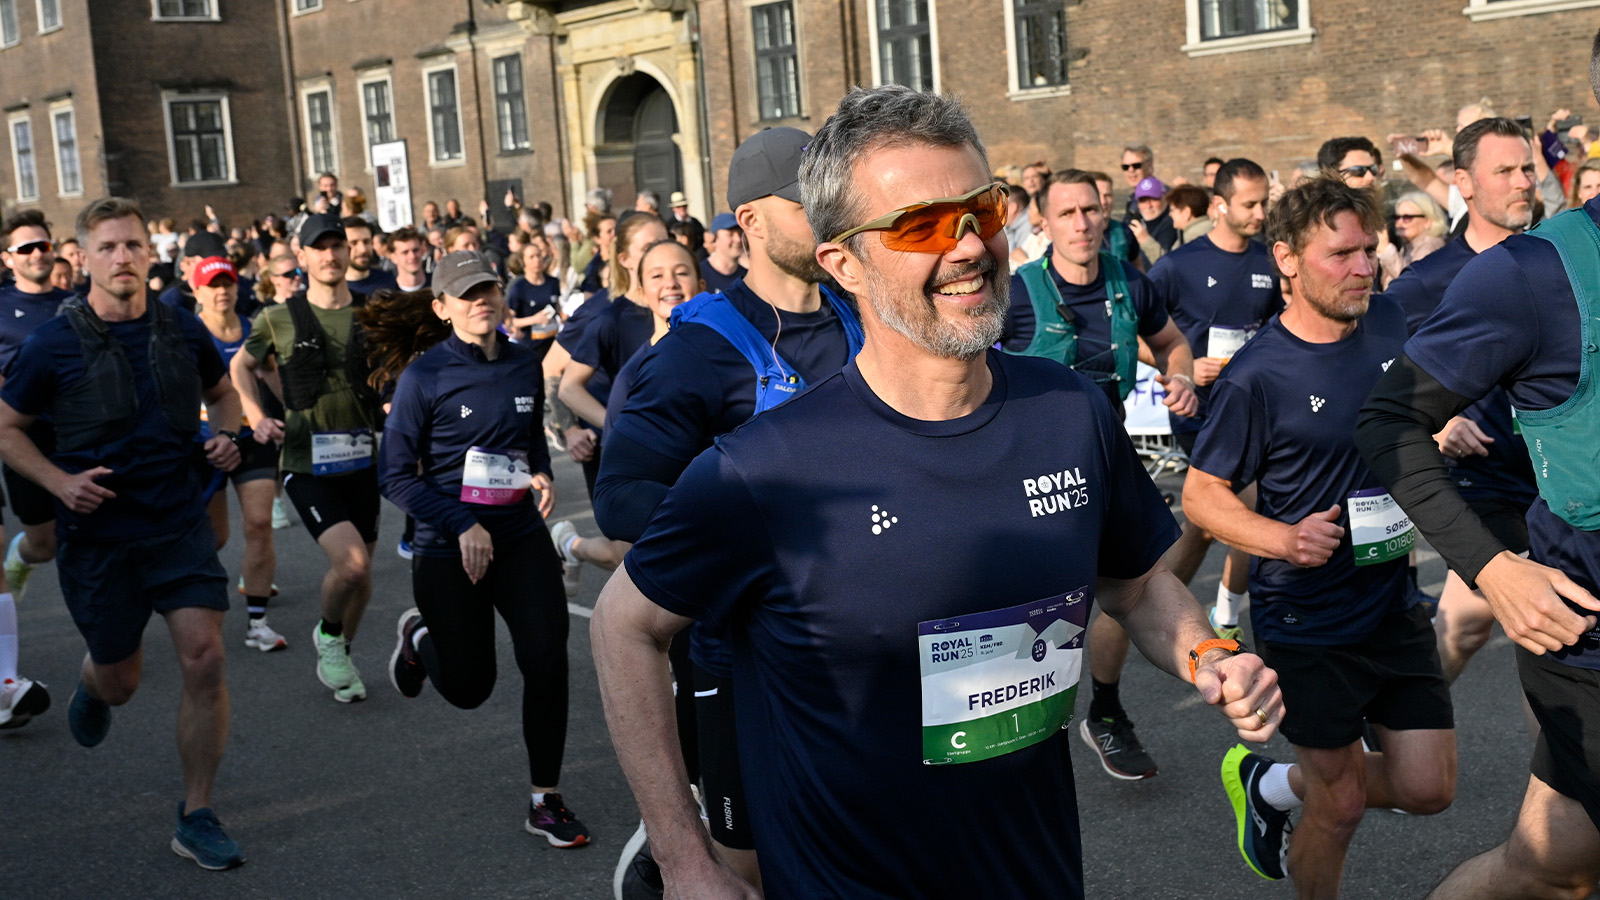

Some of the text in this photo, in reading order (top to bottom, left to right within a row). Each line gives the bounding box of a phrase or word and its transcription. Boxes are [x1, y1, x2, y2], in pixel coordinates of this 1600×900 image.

[514, 396, 535, 405] ROYA
[489, 477, 513, 486] EMILIE
[1023, 467, 1087, 497] ROYAL
[471, 489, 480, 498] D
[1368, 546, 1378, 557] C
[931, 637, 973, 653] ROYAL
[1034, 642, 1044, 654] 10
[968, 671, 1056, 711] FREDERIK
[950, 713, 1019, 749] C 1
[723, 796, 734, 831] FUSION
